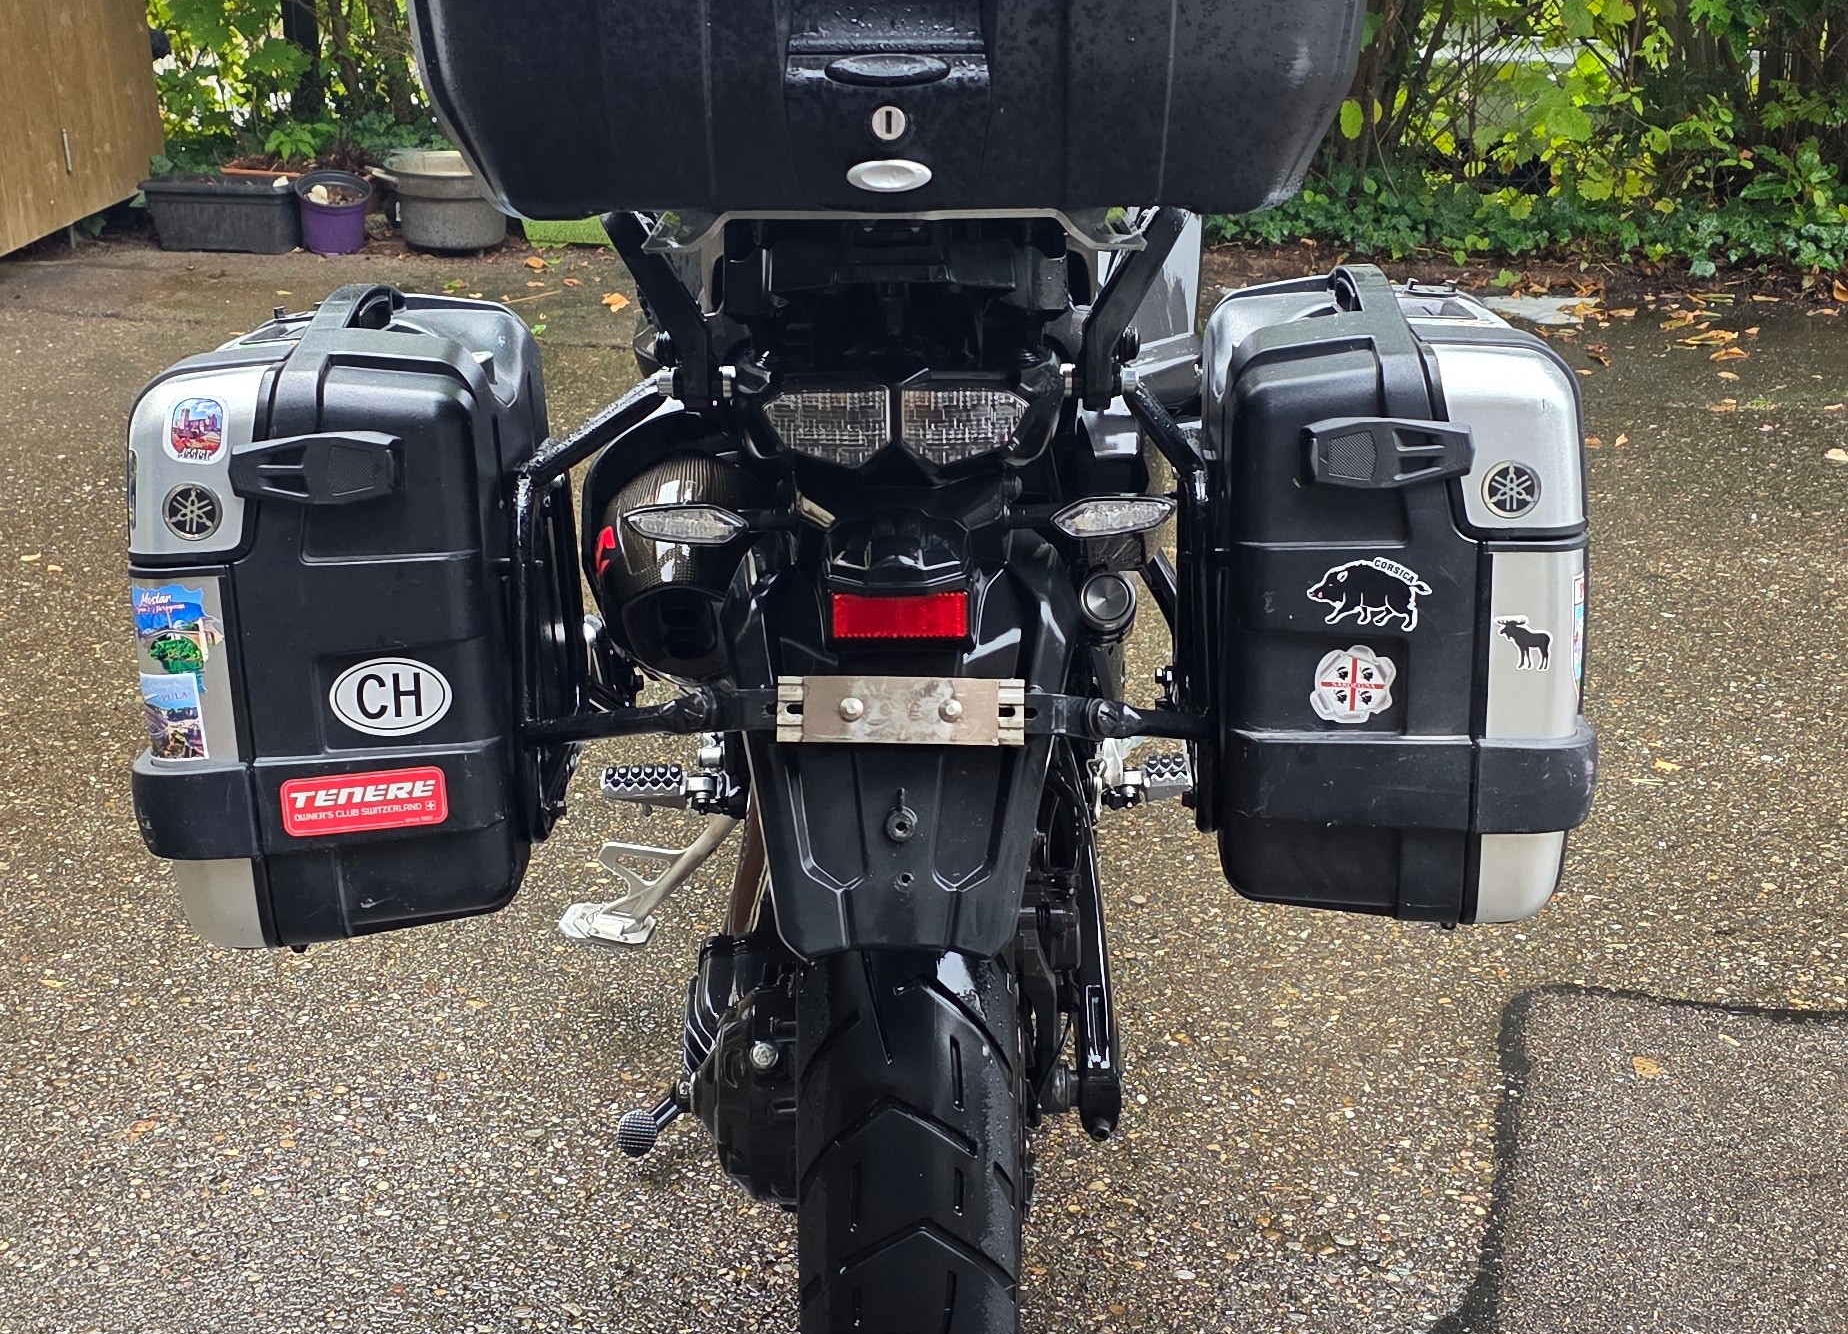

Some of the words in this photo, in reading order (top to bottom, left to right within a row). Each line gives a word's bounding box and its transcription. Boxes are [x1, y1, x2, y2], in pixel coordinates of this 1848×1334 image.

[1374, 559, 1415, 584] CORSICA
[356, 671, 423, 720] CH
[289, 779, 436, 809] TENERE
[293, 811, 334, 822] OWNER'S
[335, 808, 360, 818] CLUB
[360, 802, 423, 816] SWITZERLAND
